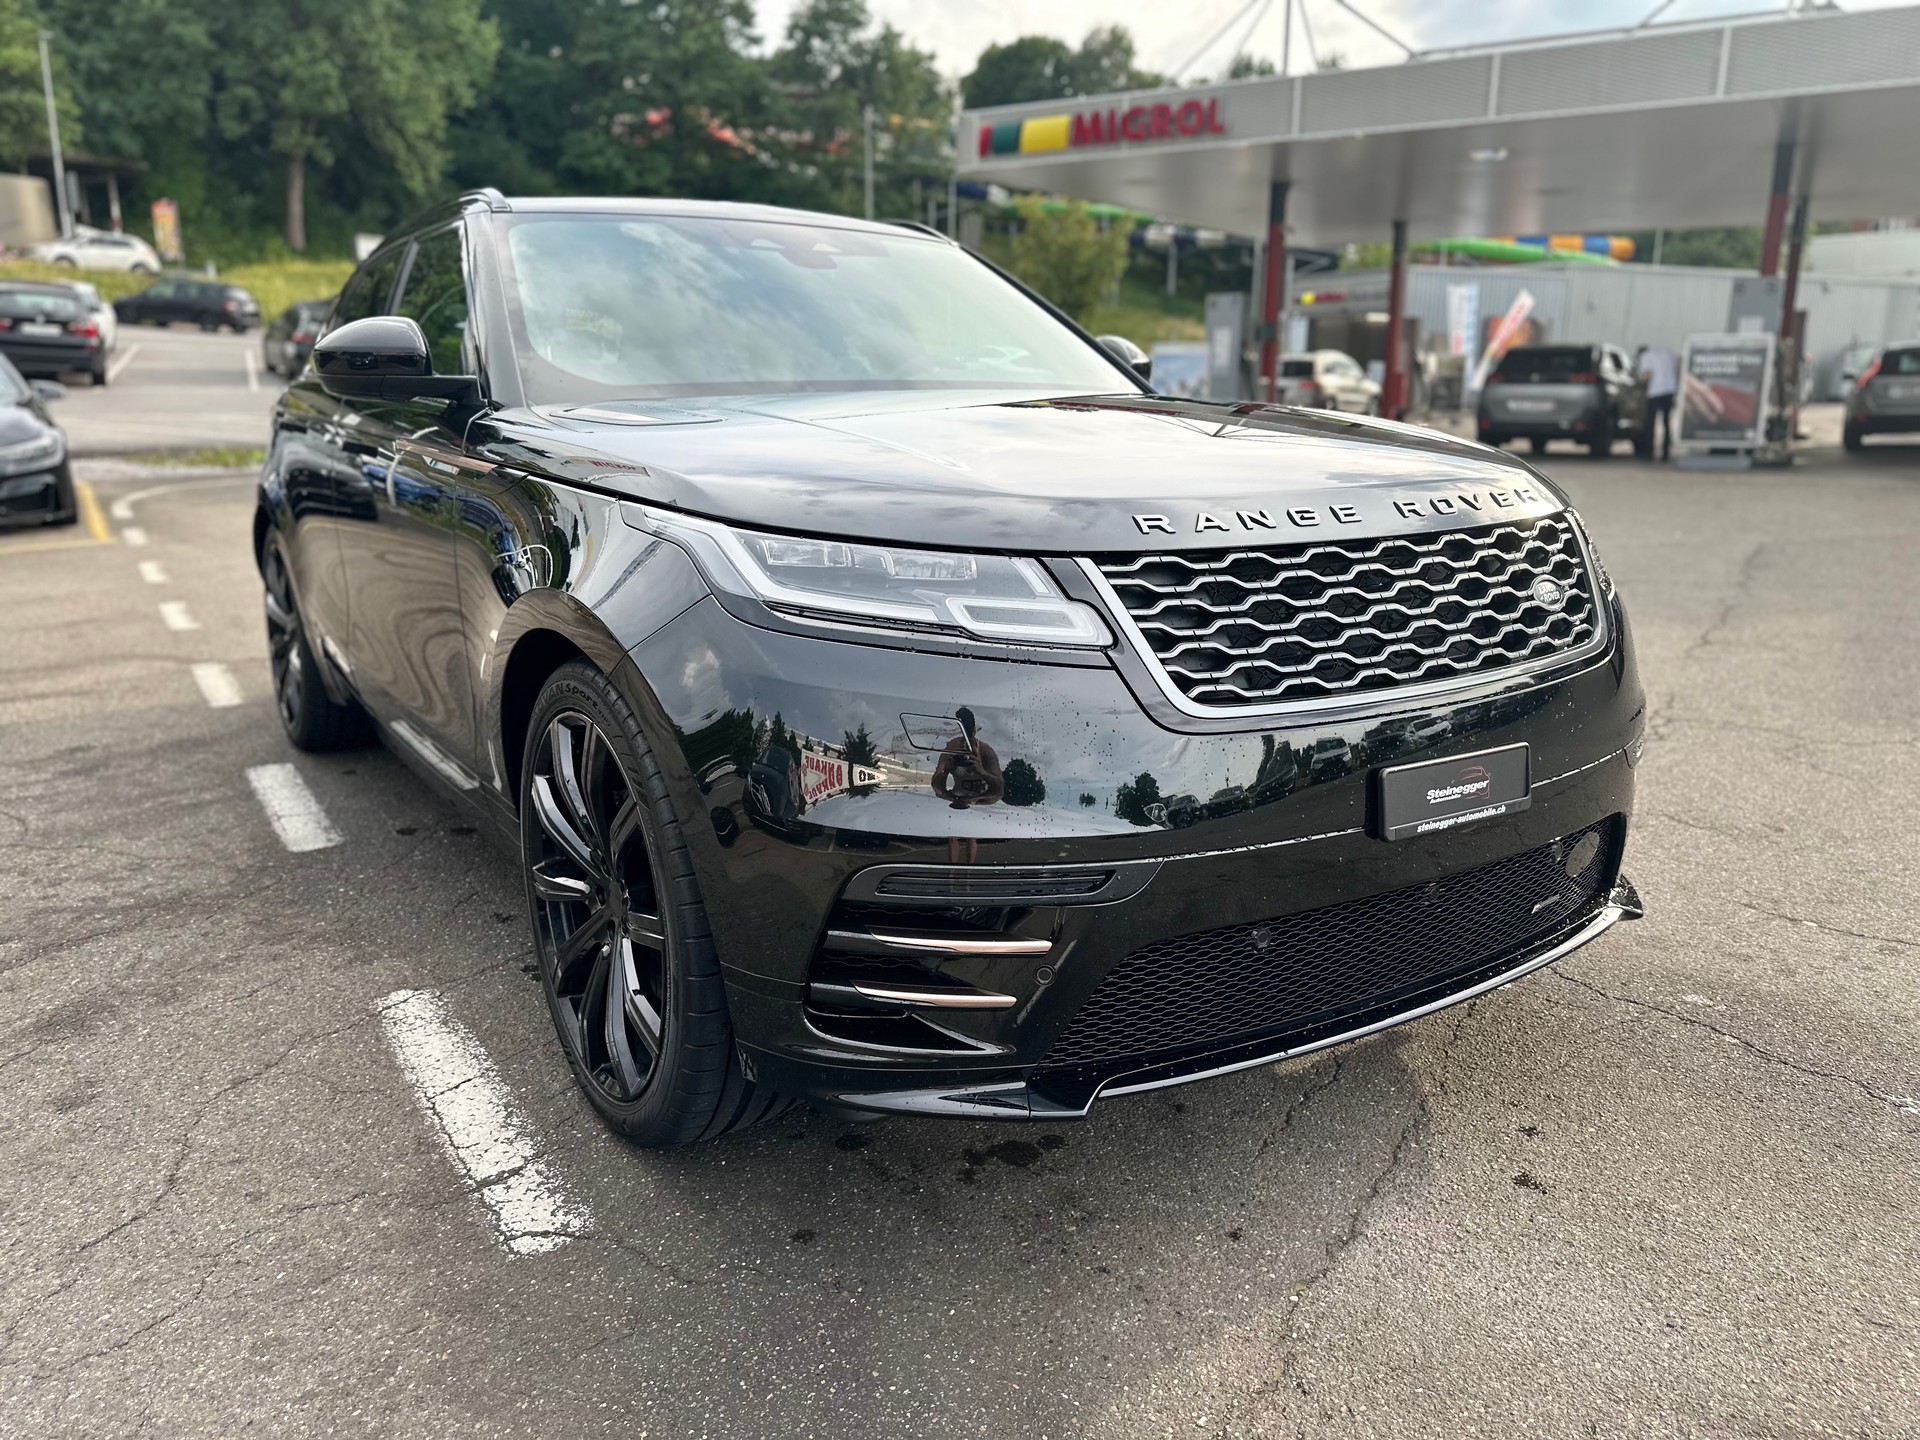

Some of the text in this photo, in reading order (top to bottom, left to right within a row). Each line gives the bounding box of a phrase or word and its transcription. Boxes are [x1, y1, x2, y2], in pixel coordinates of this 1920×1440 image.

[1072, 97, 1225, 147] MIGROL
[1132, 488, 1540, 534] RANGE ROVER
[1427, 780, 1490, 800] Steinegger
[1417, 804, 1506, 833] steinegger-automobile.ch
